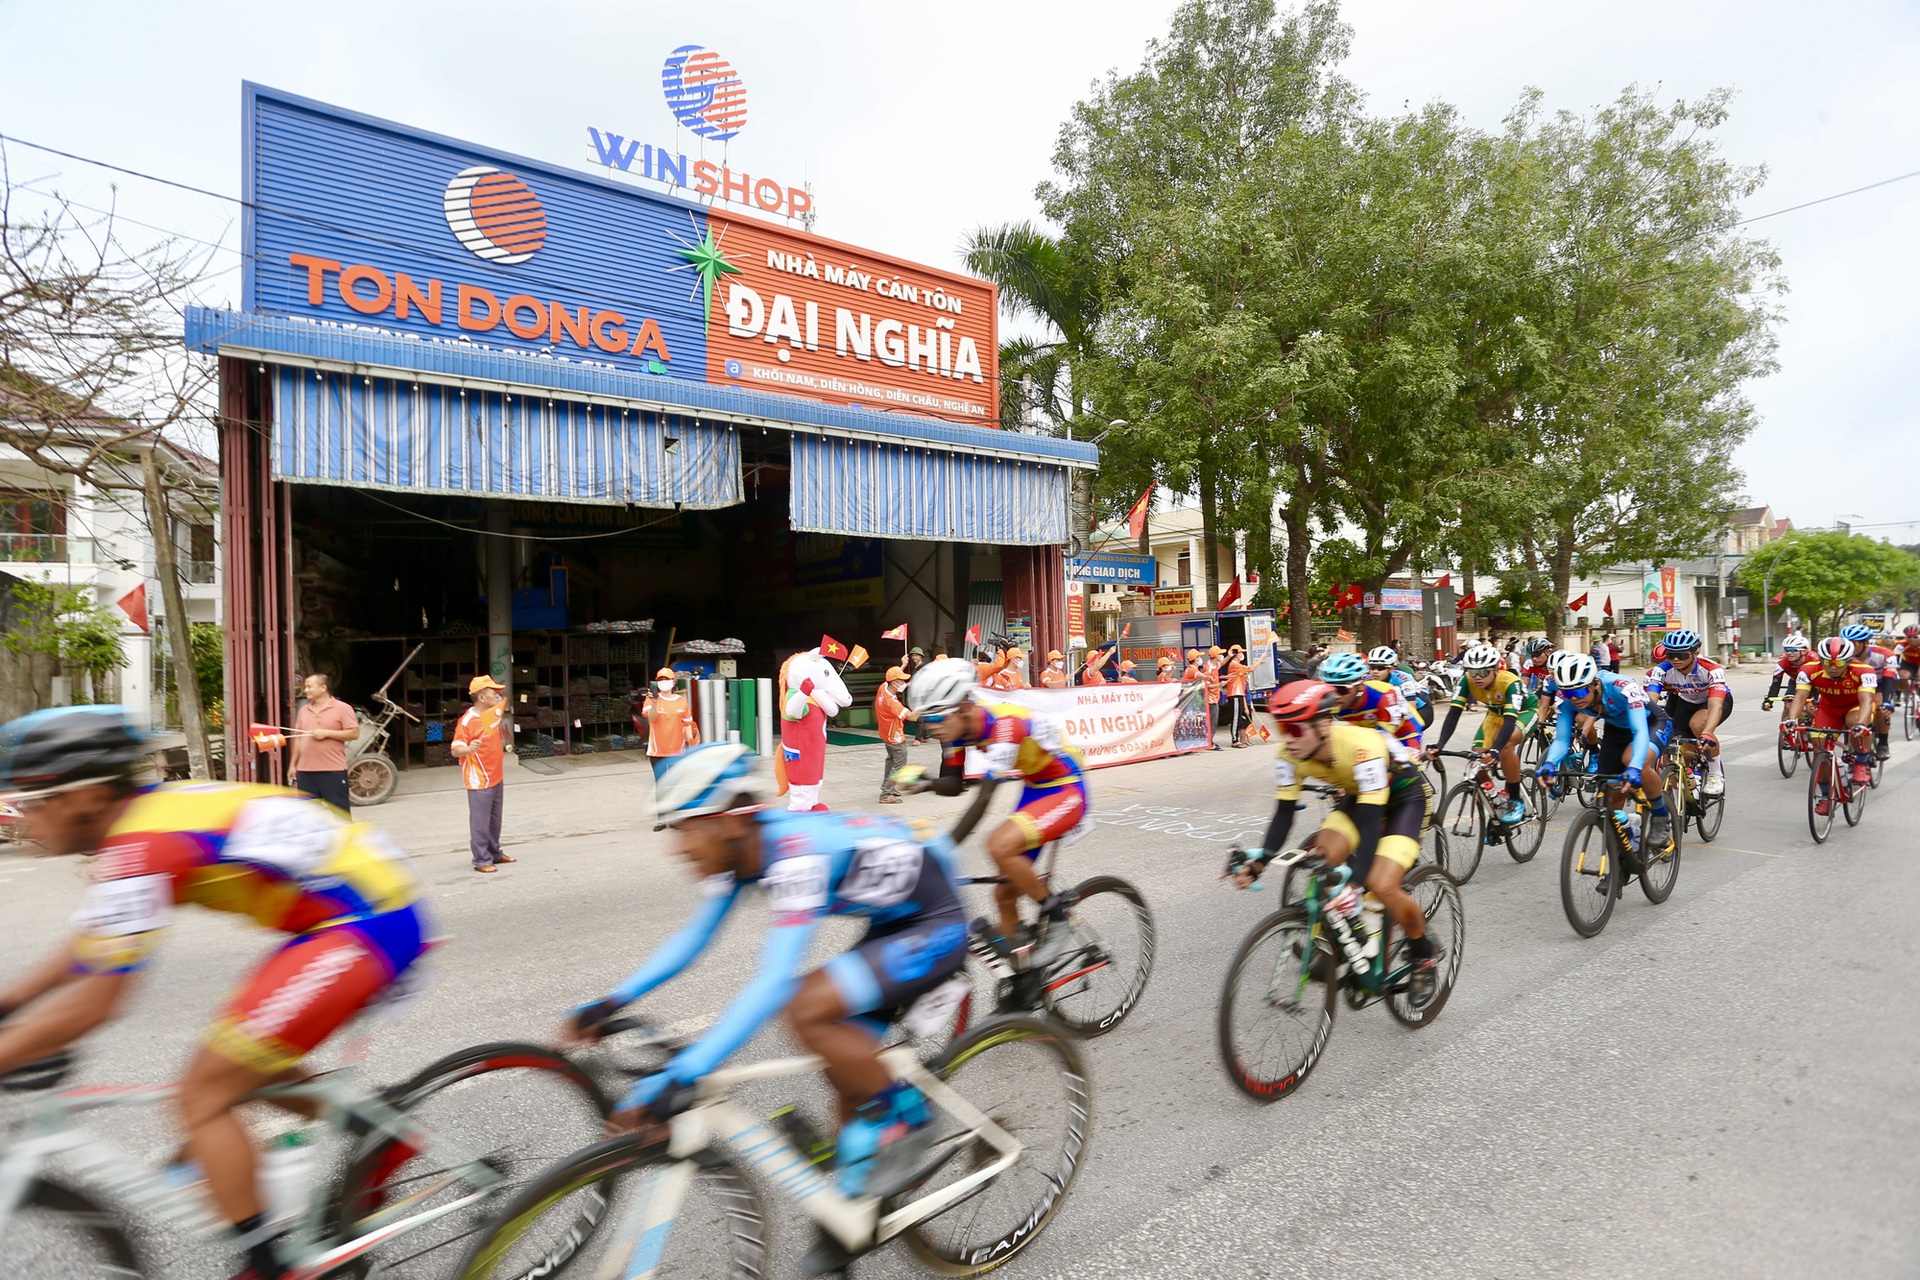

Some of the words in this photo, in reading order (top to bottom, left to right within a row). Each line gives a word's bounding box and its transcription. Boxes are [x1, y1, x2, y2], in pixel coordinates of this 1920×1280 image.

[767, 249, 820, 279] NHÀ
[824, 264, 872, 292] MÁY
[876, 276, 918, 304] CÁN
[921, 287, 962, 315] TÔN
[289, 253, 442, 325] TON
[458, 283, 671, 361] DONGA
[725, 283, 819, 363] ĐẠI
[835, 307, 984, 384] NGHĨA
[753, 367, 784, 383] KHỐI
[786, 373, 818, 390] NAM,
[848, 382, 885, 401] HỒNG,
[912, 392, 942, 410] CHÂU,
[943, 399, 970, 416] NGHỆ
[971, 405, 985, 416] AN
[1093, 566, 1115, 578] GIAO
[1118, 567, 1141, 580] DỊCH
[1133, 648, 1153, 660] SINH
[1077, 692, 1099, 705] NHÀ
[1101, 691, 1121, 704] MÁY
[1124, 691, 1144, 703] TÔN
[1065, 717, 1096, 739] ĐẠI
[1101, 711, 1155, 734] NGHĨA
[1088, 744, 1118, 757] MỪNG
[1120, 740, 1148, 754] ĐOÀN
